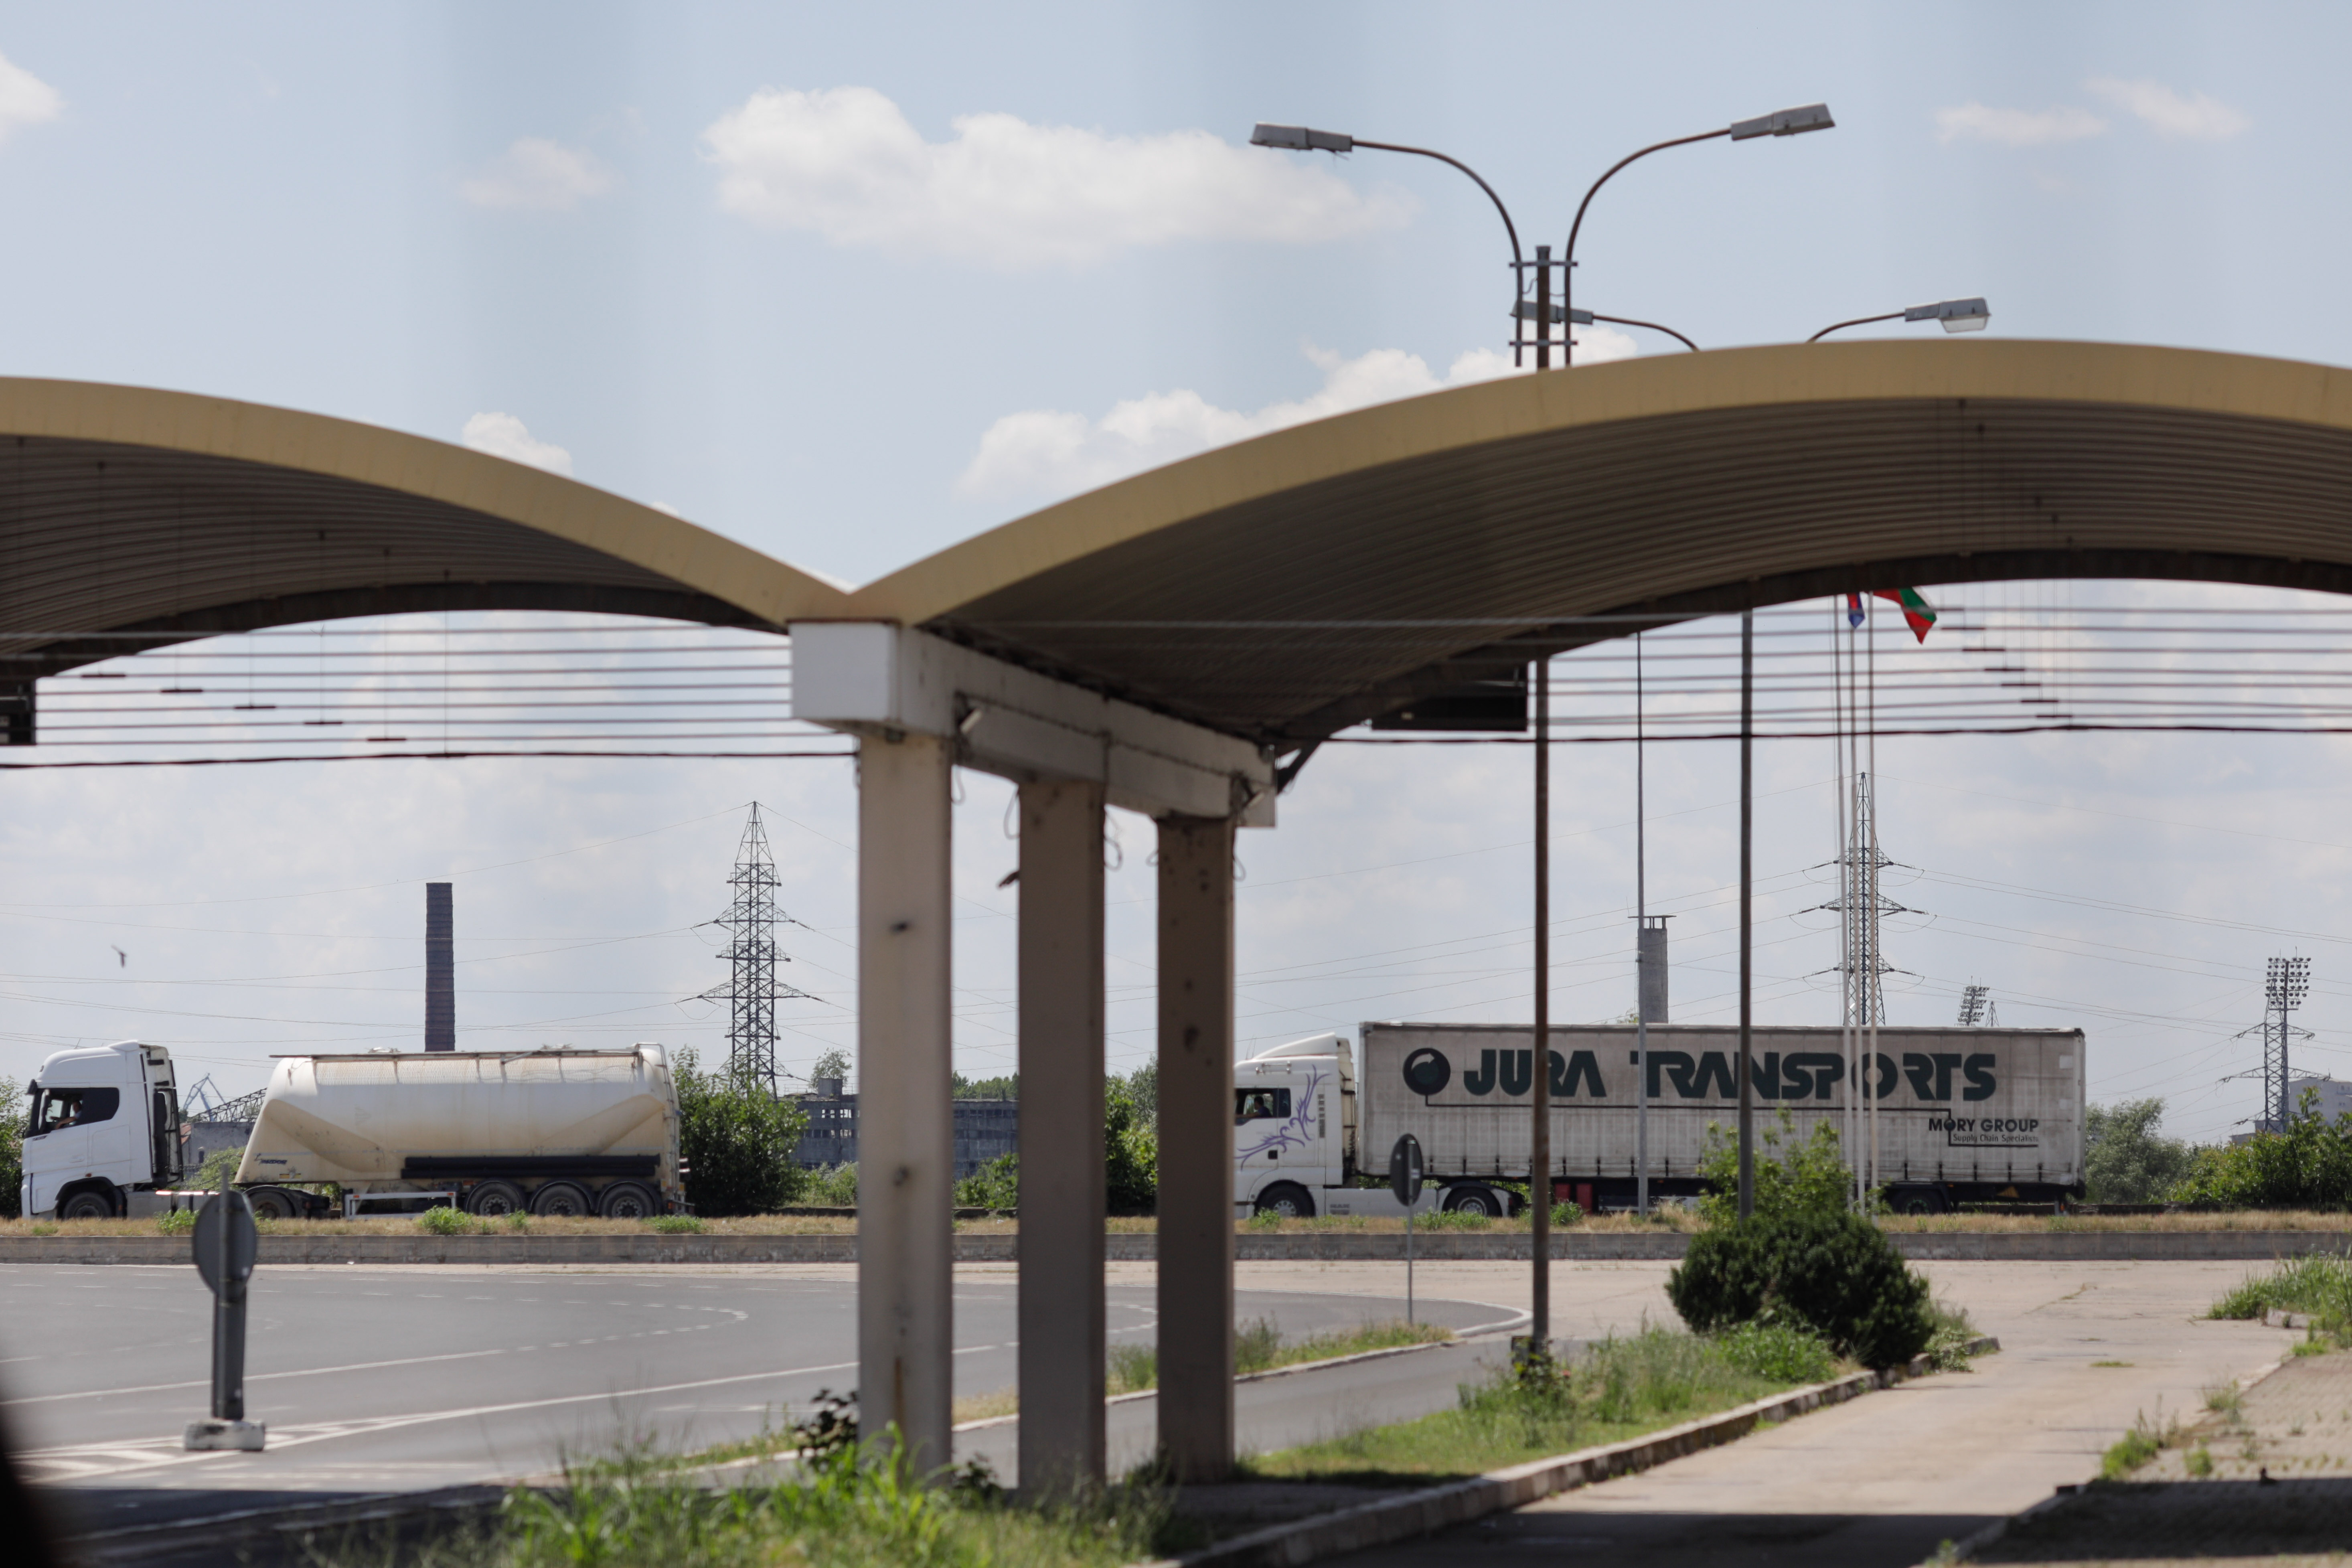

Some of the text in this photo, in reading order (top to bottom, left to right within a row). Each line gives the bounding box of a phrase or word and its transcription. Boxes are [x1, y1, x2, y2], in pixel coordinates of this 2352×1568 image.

[1464, 1049, 1996, 1101] JURA TRANSPORTS
[1929, 1118, 2039, 1132] MORY GROUP
[1953, 1134, 1977, 1143] Supply
[1980, 1134, 1998, 1142] Chain
